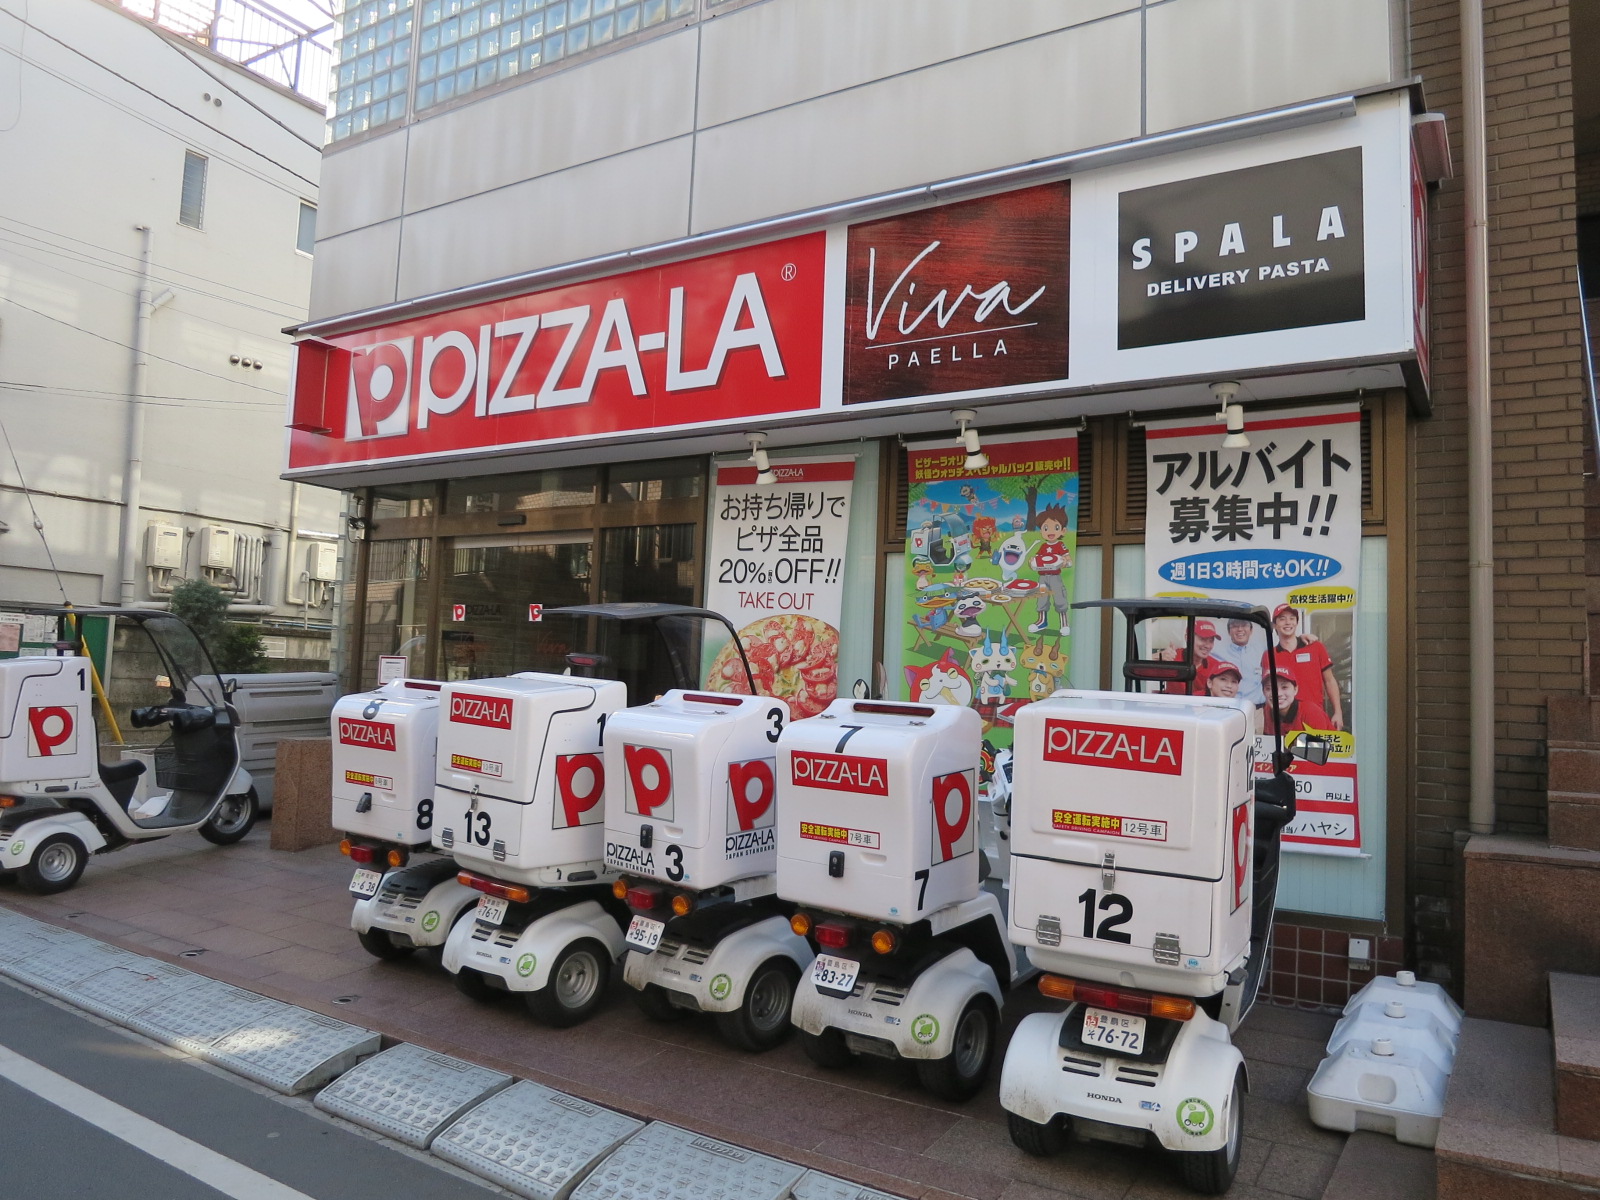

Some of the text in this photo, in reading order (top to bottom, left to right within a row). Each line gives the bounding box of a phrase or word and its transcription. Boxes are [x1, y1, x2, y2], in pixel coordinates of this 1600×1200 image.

[1131, 205, 1346, 270] SPALA
[865, 240, 1046, 341] Viva
[1146, 257, 1330, 297] DELIVERY PASTA
[887, 337, 1008, 370] PAELLA
[1153, 439, 1351, 495] アルバイト
[720, 492, 846, 521] お持ち帰りで
[1169, 491, 1338, 543] 募集中!!
[737, 524, 824, 553] ピザ全品
[1170, 558, 1330, 581] 週1日3時間でもOK!!
[738, 591, 814, 610] TAKE OUT
[77, 668, 85, 691] 1
[452, 697, 510, 724] PIZZA-LA
[766, 707, 783, 743] 3
[340, 722, 394, 746] PIZZA-LA
[835, 724, 864, 753] 7
[1048, 726, 1176, 766] PIZZA-LA
[794, 757, 885, 789] PIZZA-LA
[1325, 792, 1351, 802] 円以上
[416, 798, 433, 830] 8
[465, 811, 491, 846] 13
[1053, 811, 1162, 837] 安全運転実施中 12号車
[1301, 821, 1348, 836] ハヤシ
[607, 842, 654, 868] PIZZA-LA
[726, 829, 774, 853] PIZZA-LA
[665, 844, 684, 882] 3
[914, 869, 930, 911] 7
[481, 905, 502, 921] 76-71
[1078, 888, 1134, 945] 12
[634, 928, 658, 945] 95-19
[821, 969, 854, 987] 83-27
[848, 1008, 873, 1019] HONDA
[1098, 1026, 1139, 1050] 76-72
[1087, 1092, 1122, 1104] HONDA
